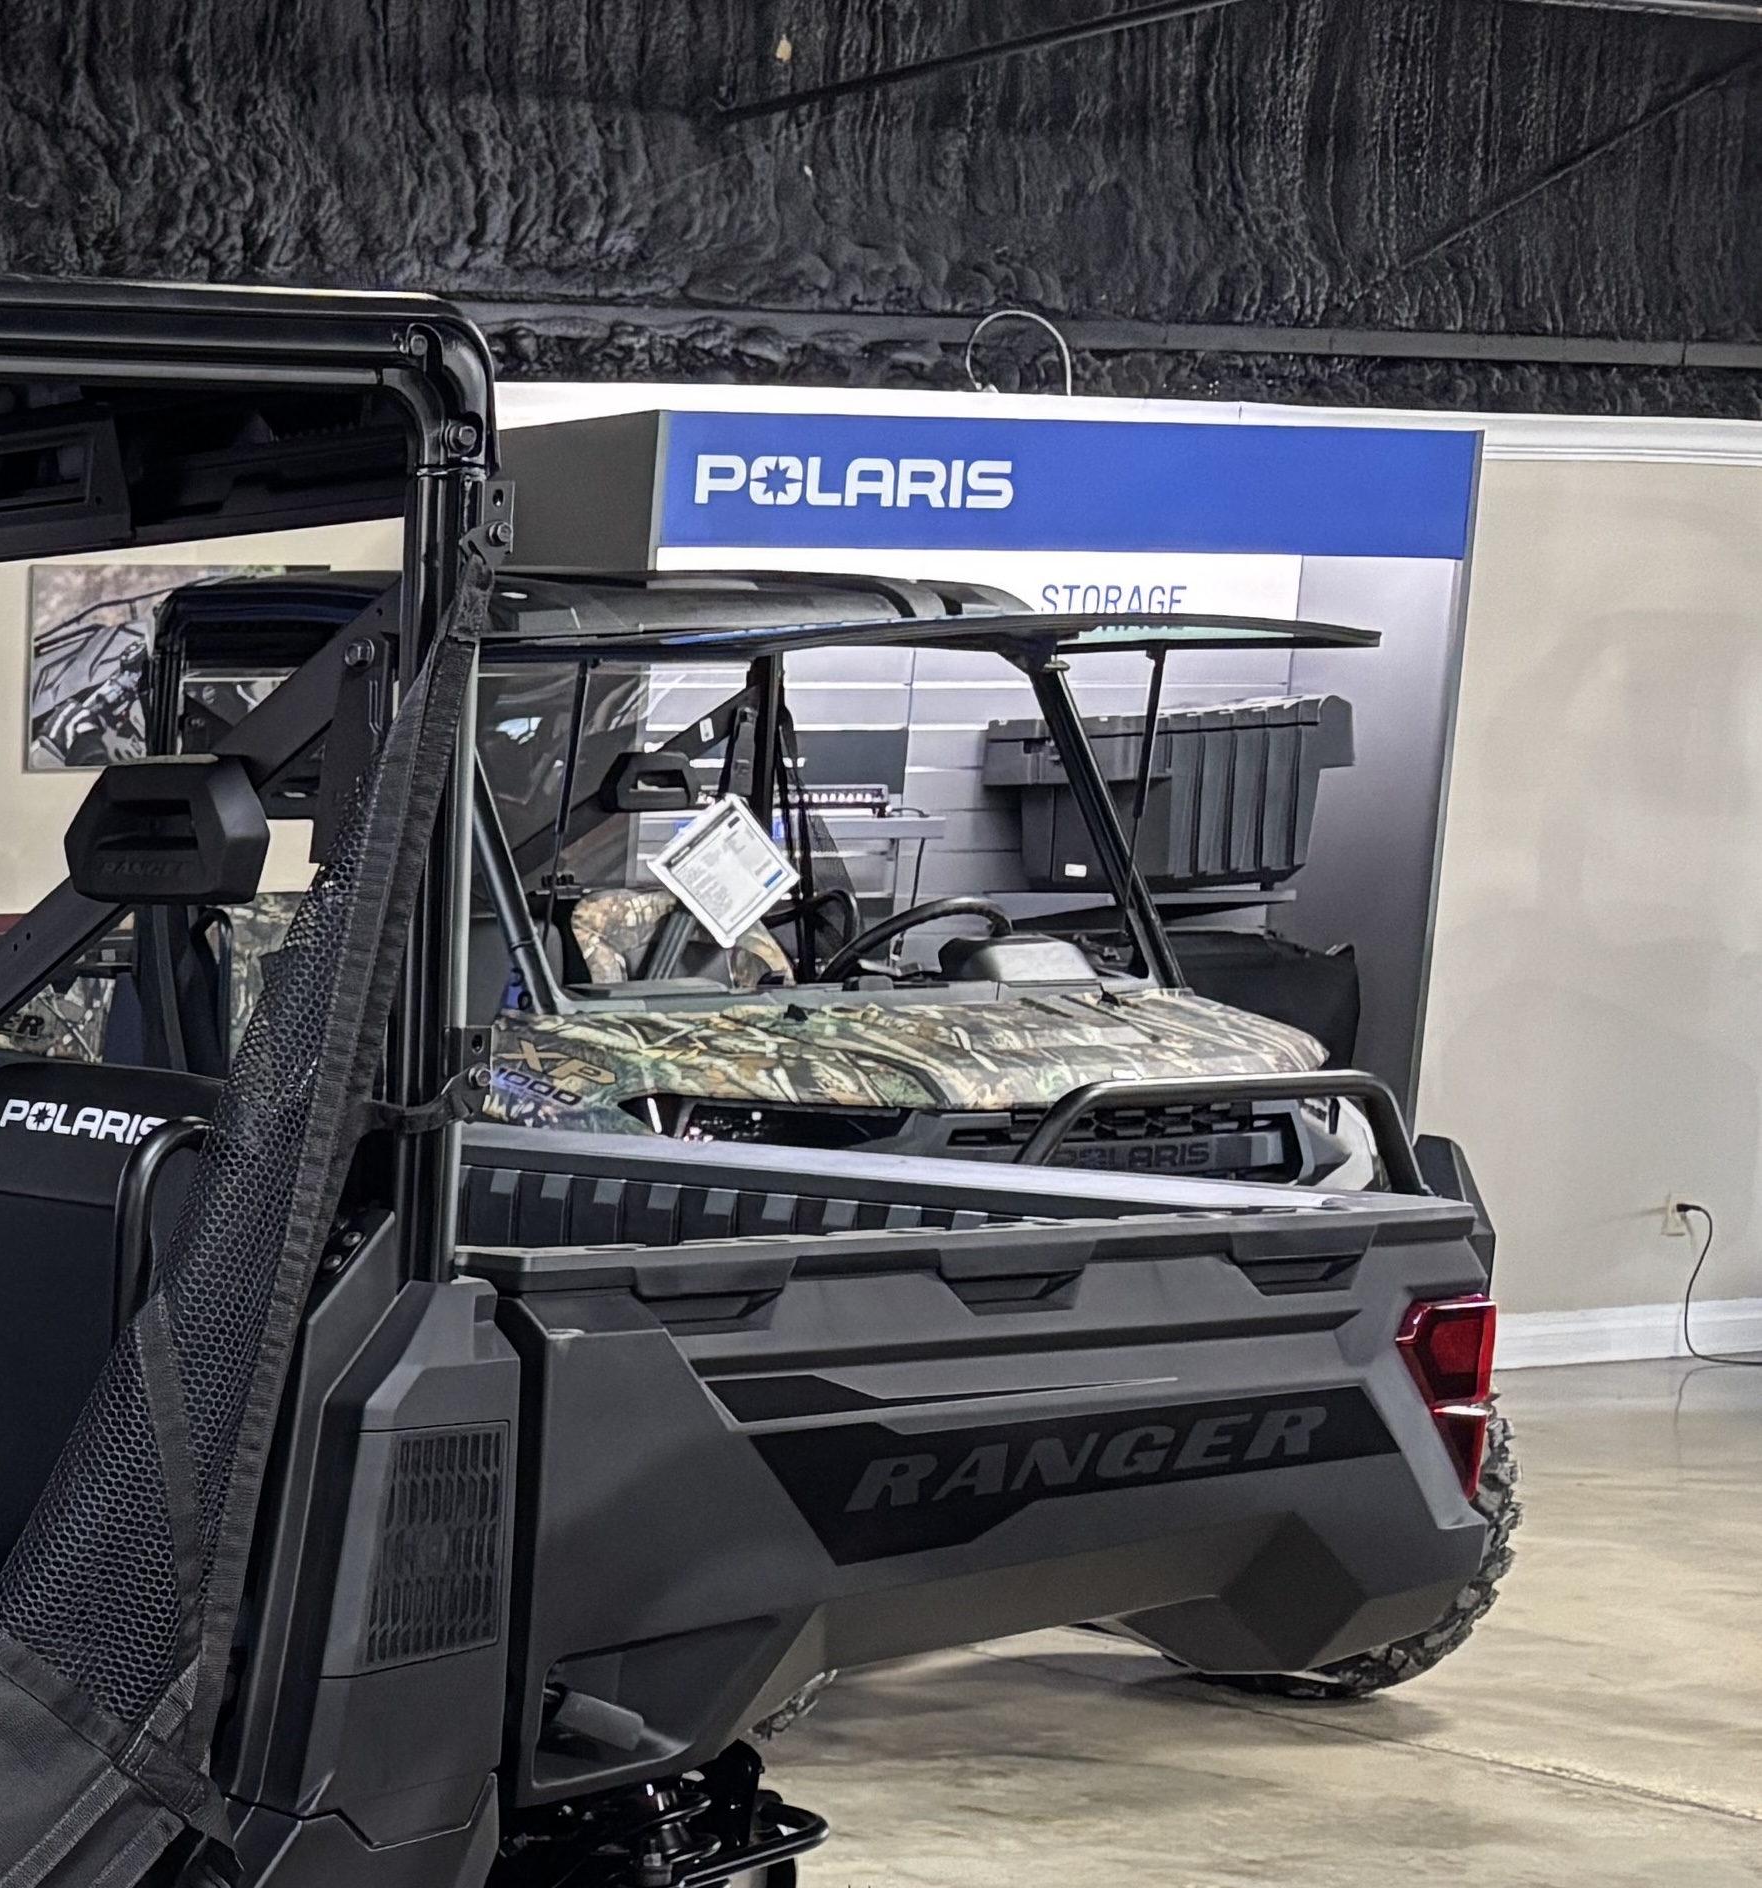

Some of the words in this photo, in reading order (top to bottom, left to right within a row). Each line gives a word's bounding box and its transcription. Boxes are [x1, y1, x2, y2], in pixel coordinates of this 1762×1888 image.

[694, 454, 1014, 509] POLARIS
[494, 1039, 617, 1085] XP
[0, 1098, 167, 1146] POLARIS
[844, 1405, 1328, 1513] RANGER
